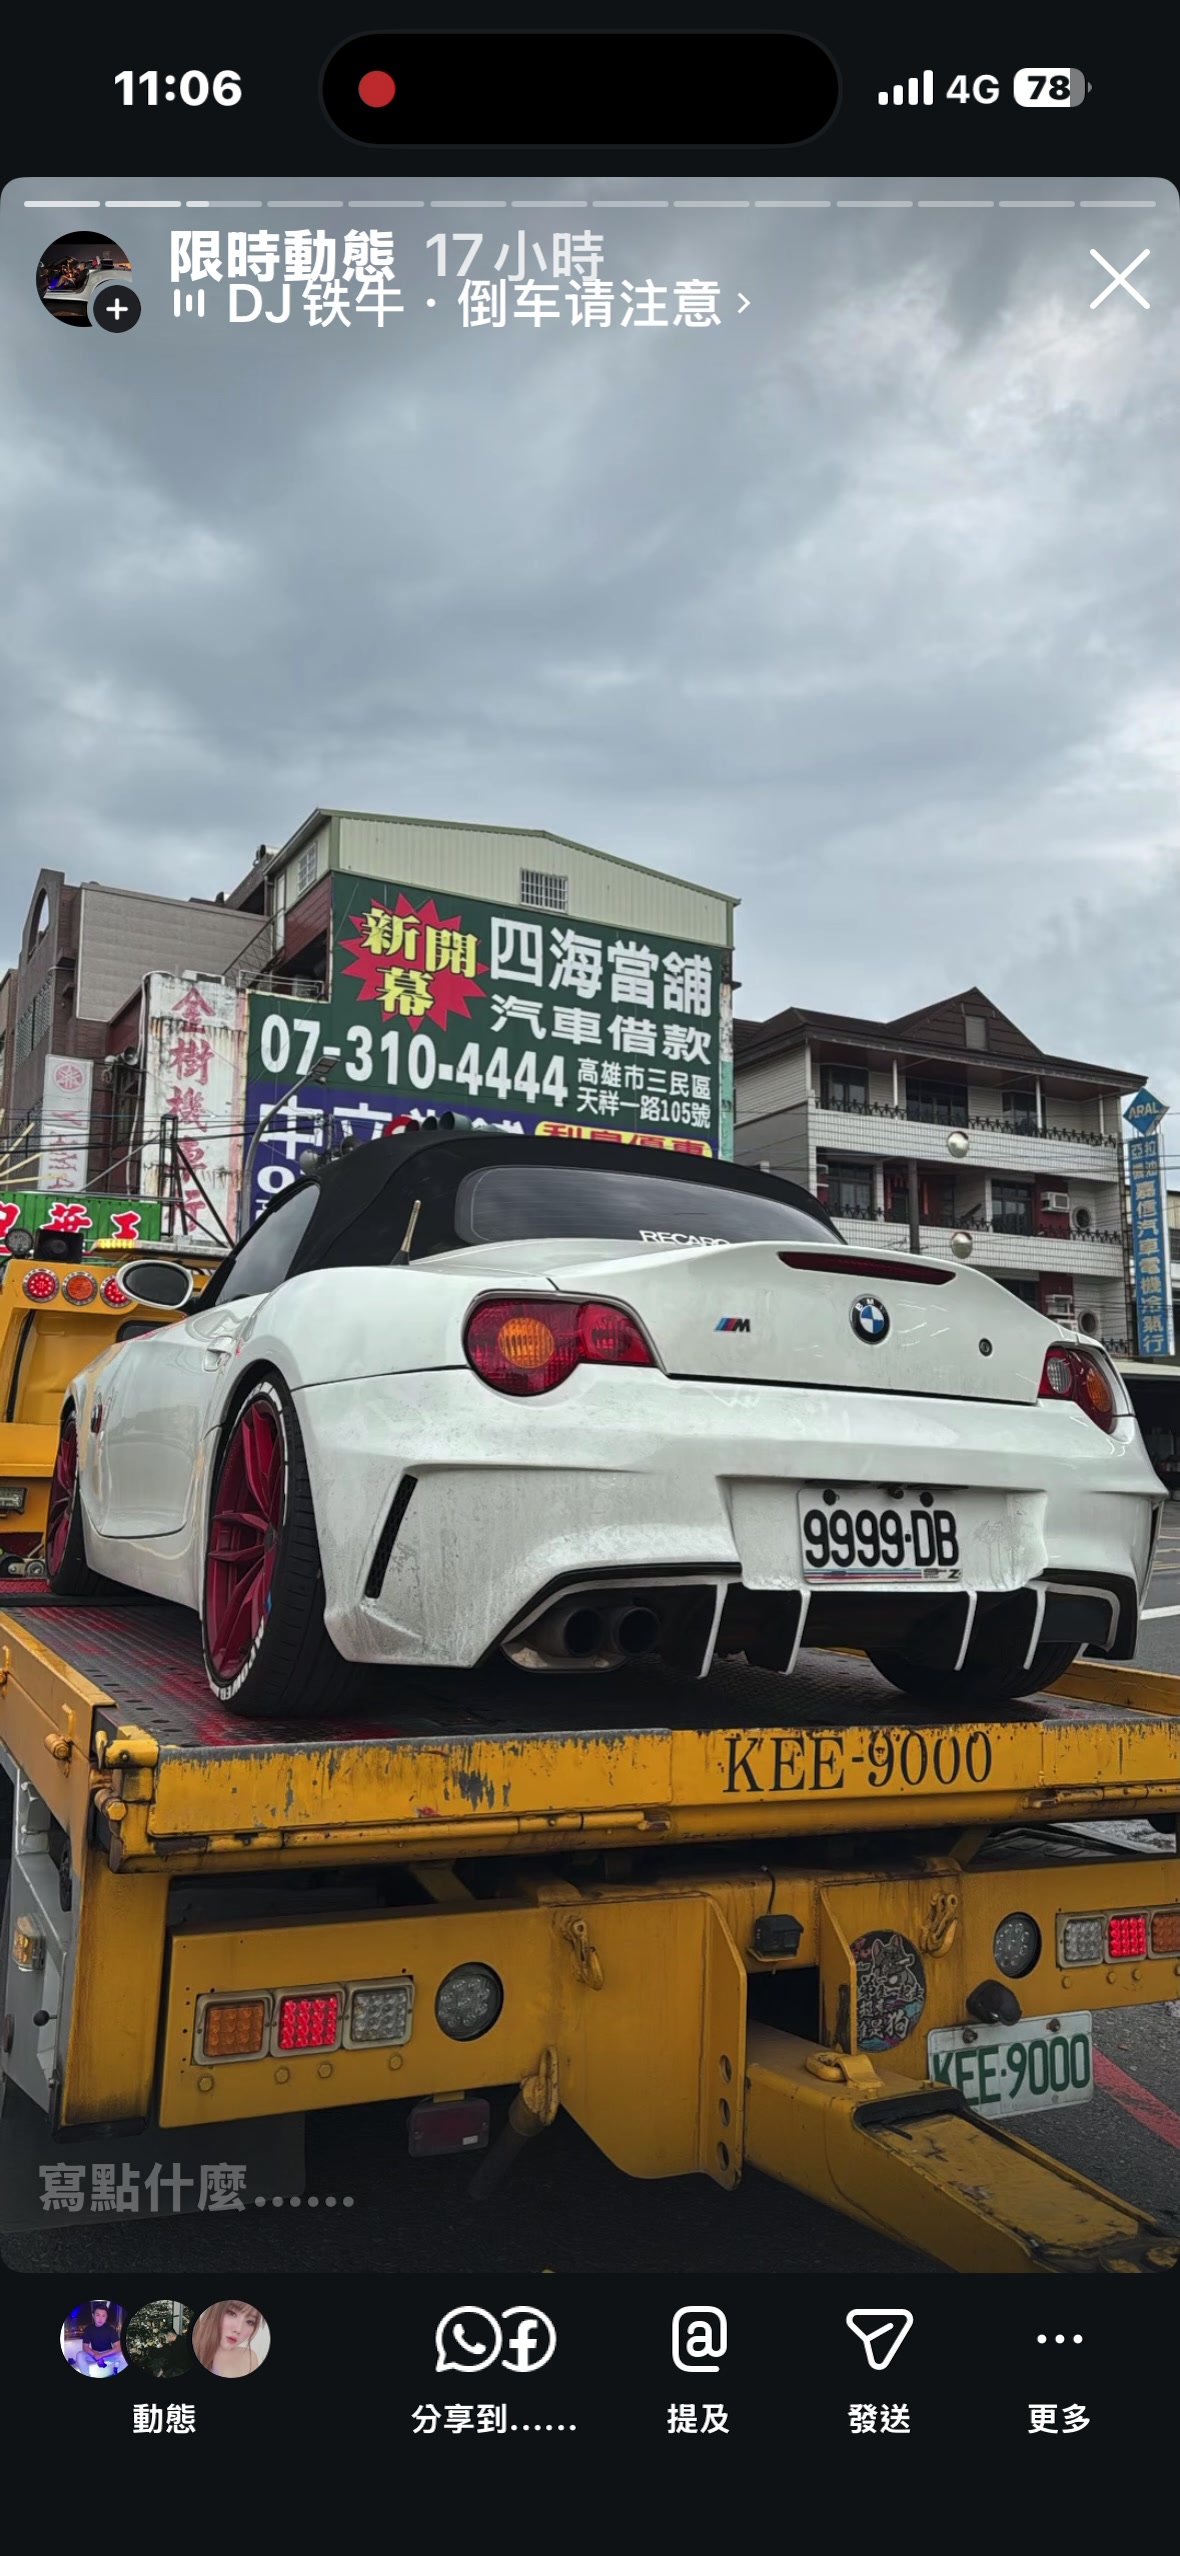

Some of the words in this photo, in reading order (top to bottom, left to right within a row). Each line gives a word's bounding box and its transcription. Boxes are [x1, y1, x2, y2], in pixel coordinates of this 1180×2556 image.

[361, 907, 479, 978] 新開
[375, 966, 435, 1017] 幕
[490, 993, 712, 1065] 汽車借款
[260, 1013, 569, 1108] 07-310-4444
[576, 1056, 712, 1101] 高雄市三民區
[576, 1086, 711, 1129] 天祥一路105號
[1128, 1101, 1160, 1119] ARAL
[638, 1229, 731, 1247] RECARO
[722, 1730, 993, 1793] KEE-9000
